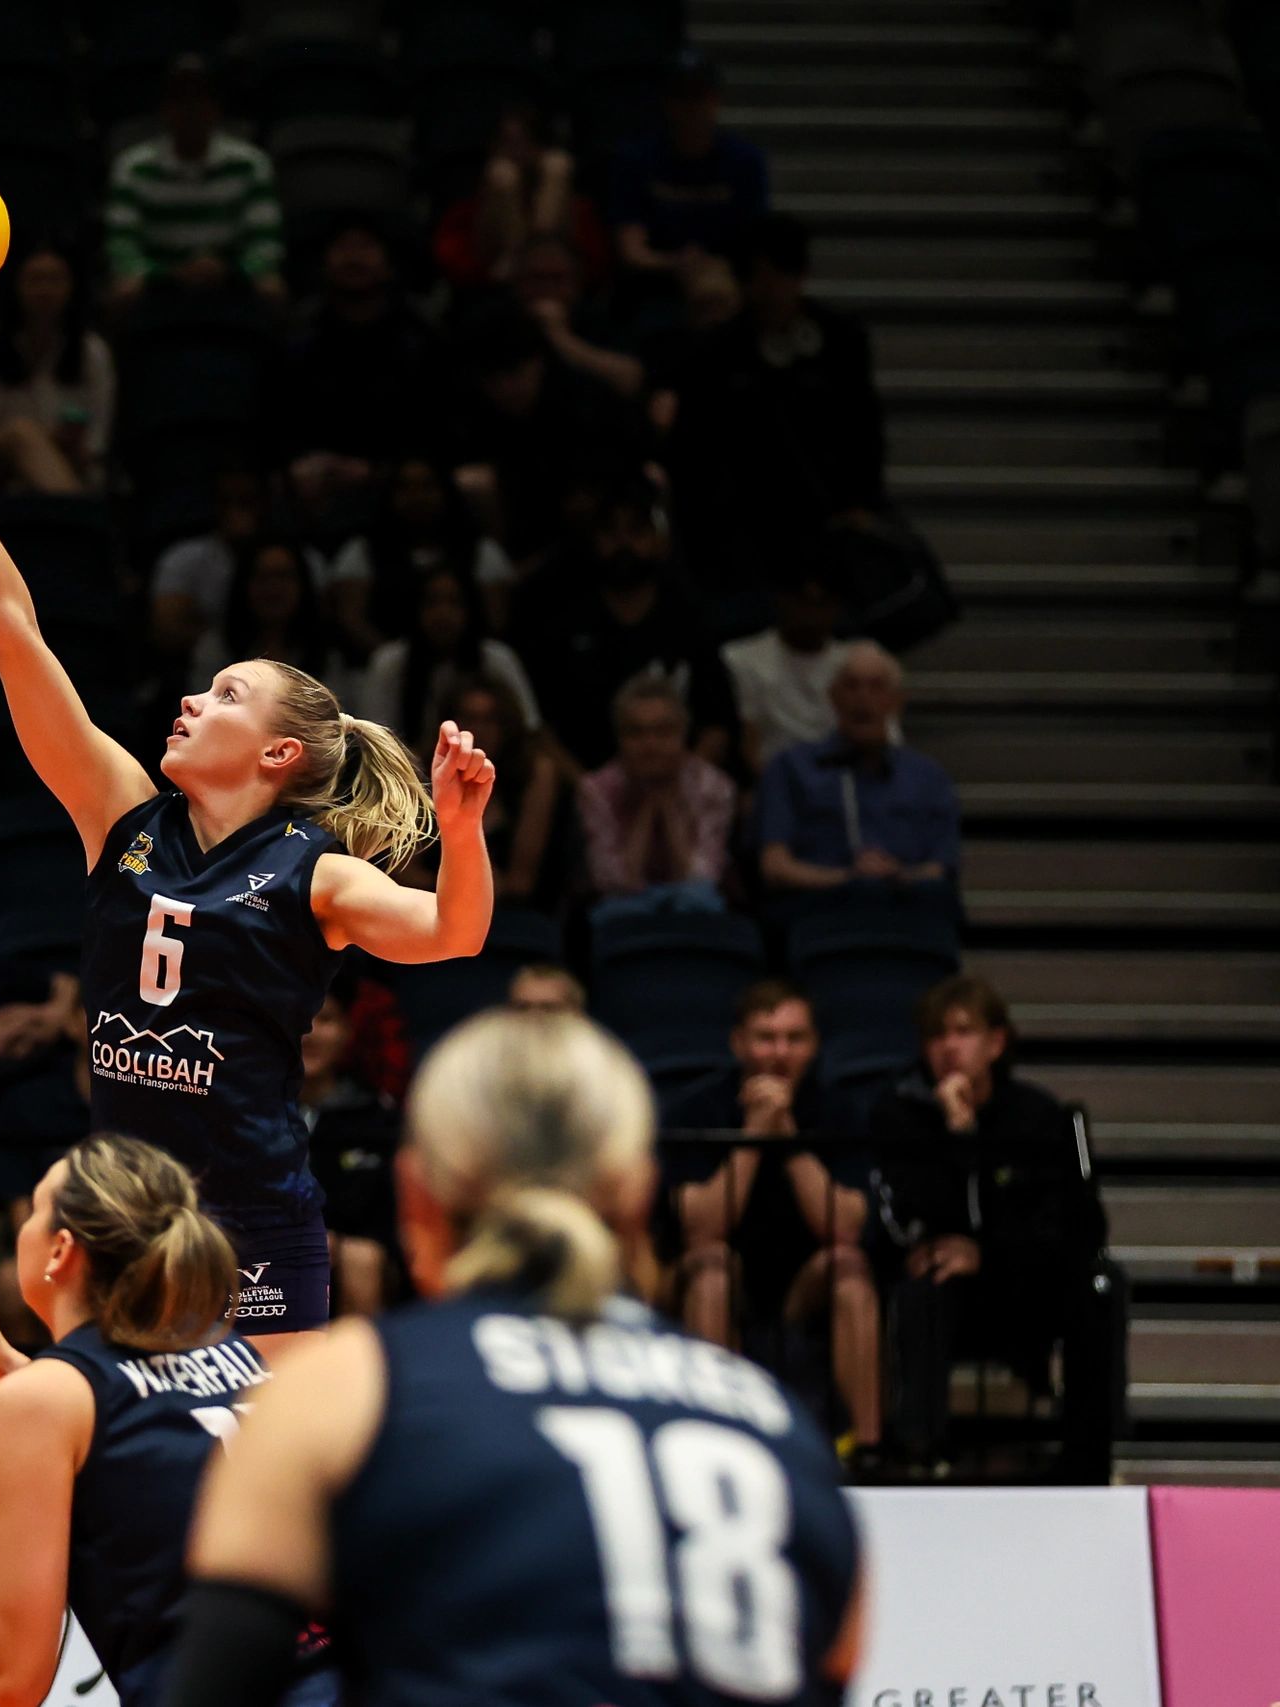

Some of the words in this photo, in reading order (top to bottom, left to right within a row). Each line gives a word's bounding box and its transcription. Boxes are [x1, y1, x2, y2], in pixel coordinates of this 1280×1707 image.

[140, 893, 196, 1007] 6
[92, 1040, 215, 1086] COOLIBAH
[93, 1064, 116, 1080] Custom
[117, 1071, 137, 1084] Built
[139, 1076, 209, 1096] Transportables
[237, 1288, 284, 1298] OLLEYBALL
[224, 1304, 287, 1319] JOUST
[532, 1403, 806, 1703] 18
[872, 1682, 1103, 1707] GREATER
